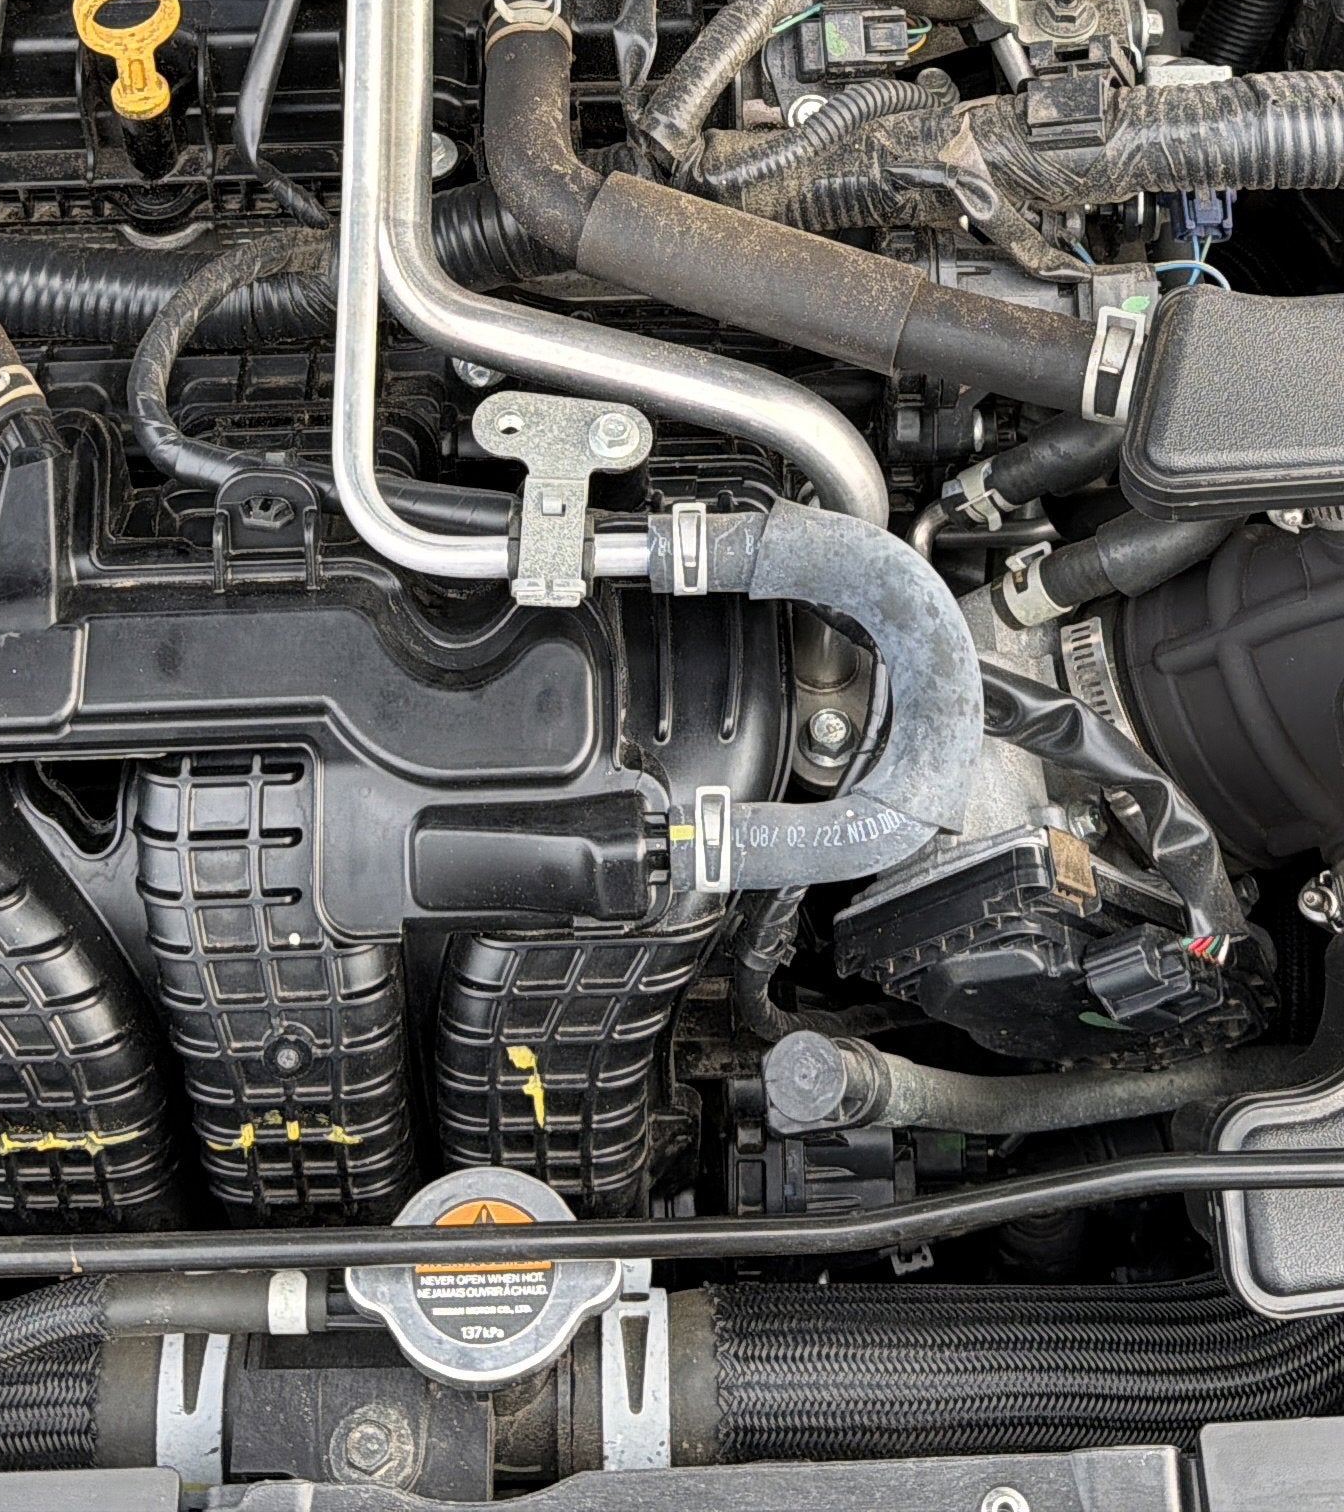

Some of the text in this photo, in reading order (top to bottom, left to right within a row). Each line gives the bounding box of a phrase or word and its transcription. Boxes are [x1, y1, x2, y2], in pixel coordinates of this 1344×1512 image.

[421, 1272, 546, 1286] NEVER OPEN WHEN HOT.
[417, 1289, 430, 1298] NE
[430, 1288, 465, 1298] JAMAIS
[511, 1285, 548, 1296] CHAUD.
[461, 1326, 504, 1340] 137 kPa
